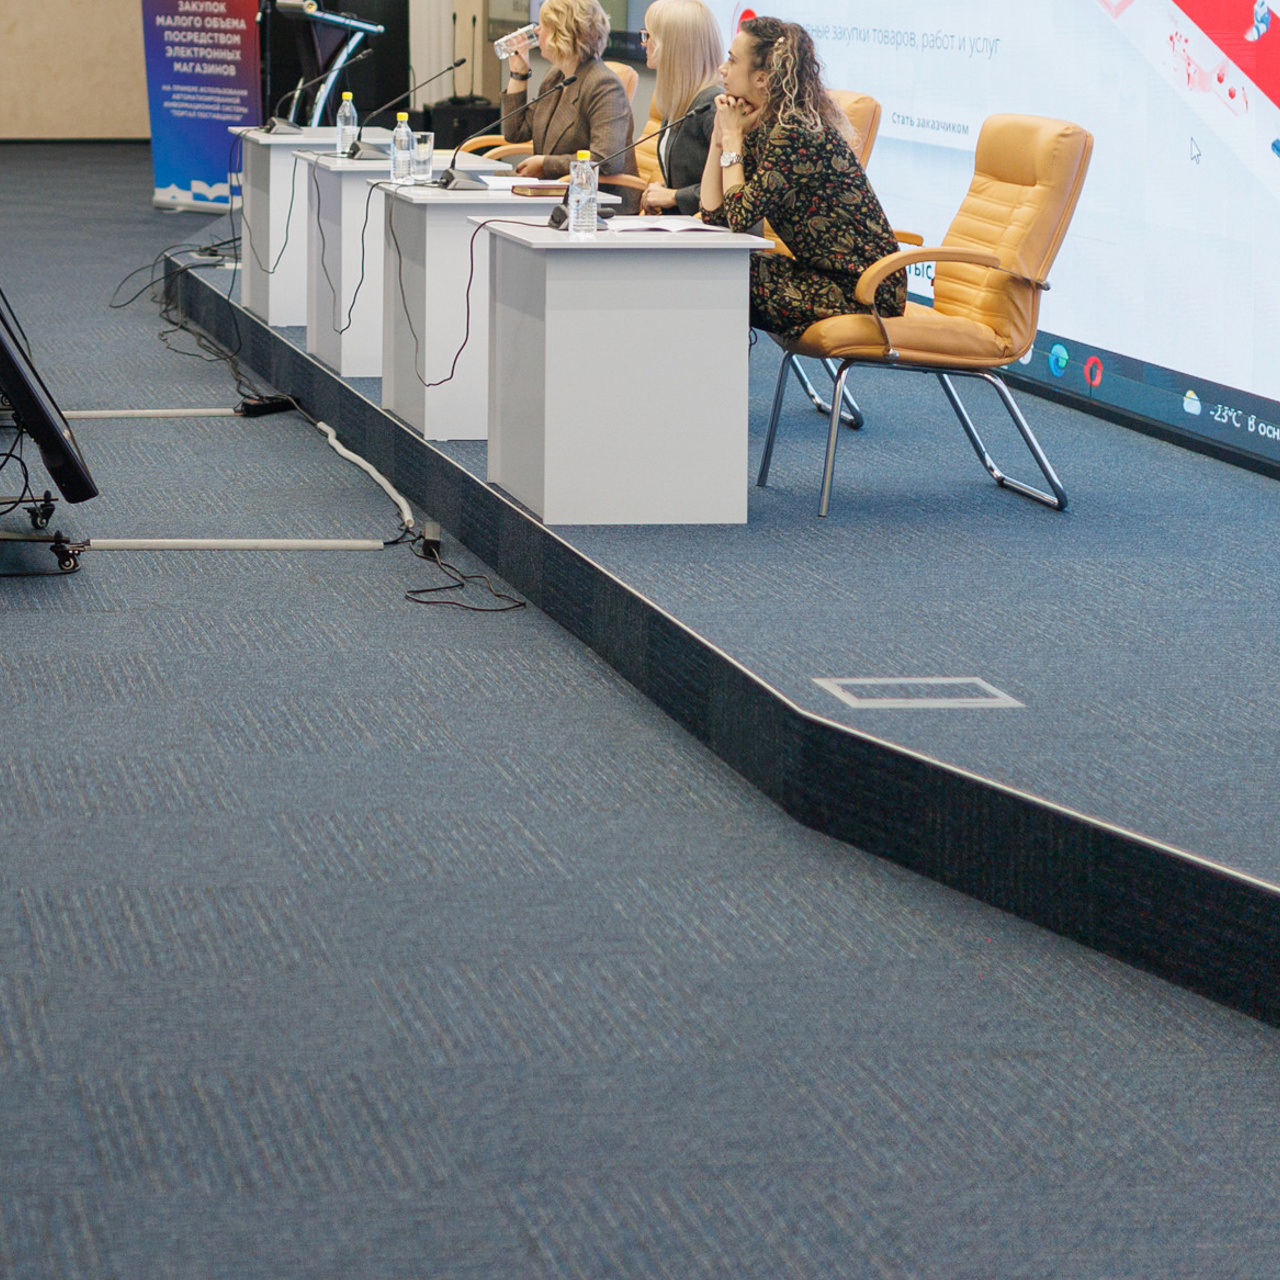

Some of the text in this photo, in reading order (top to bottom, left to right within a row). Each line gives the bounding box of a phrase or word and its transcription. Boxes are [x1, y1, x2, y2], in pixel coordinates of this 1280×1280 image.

[178, 0, 227, 13] ЗАКУПОК
[156, 15, 247, 30] МАЛОГО ОБЪЕМА
[164, 30, 241, 44] ПОСРЕДСТВОМ
[832, 25, 870, 46] закупки
[872, 27, 919, 50] товаров,
[922, 29, 955, 54] работ
[958, 37, 966, 51] и
[969, 37, 1000, 59] услуг
[165, 45, 241, 60] ЭЛЕКТРОННЫХ
[173, 61, 236, 76] МАГАЗИНОВ
[891, 111, 969, 135] Стать заказчиком
